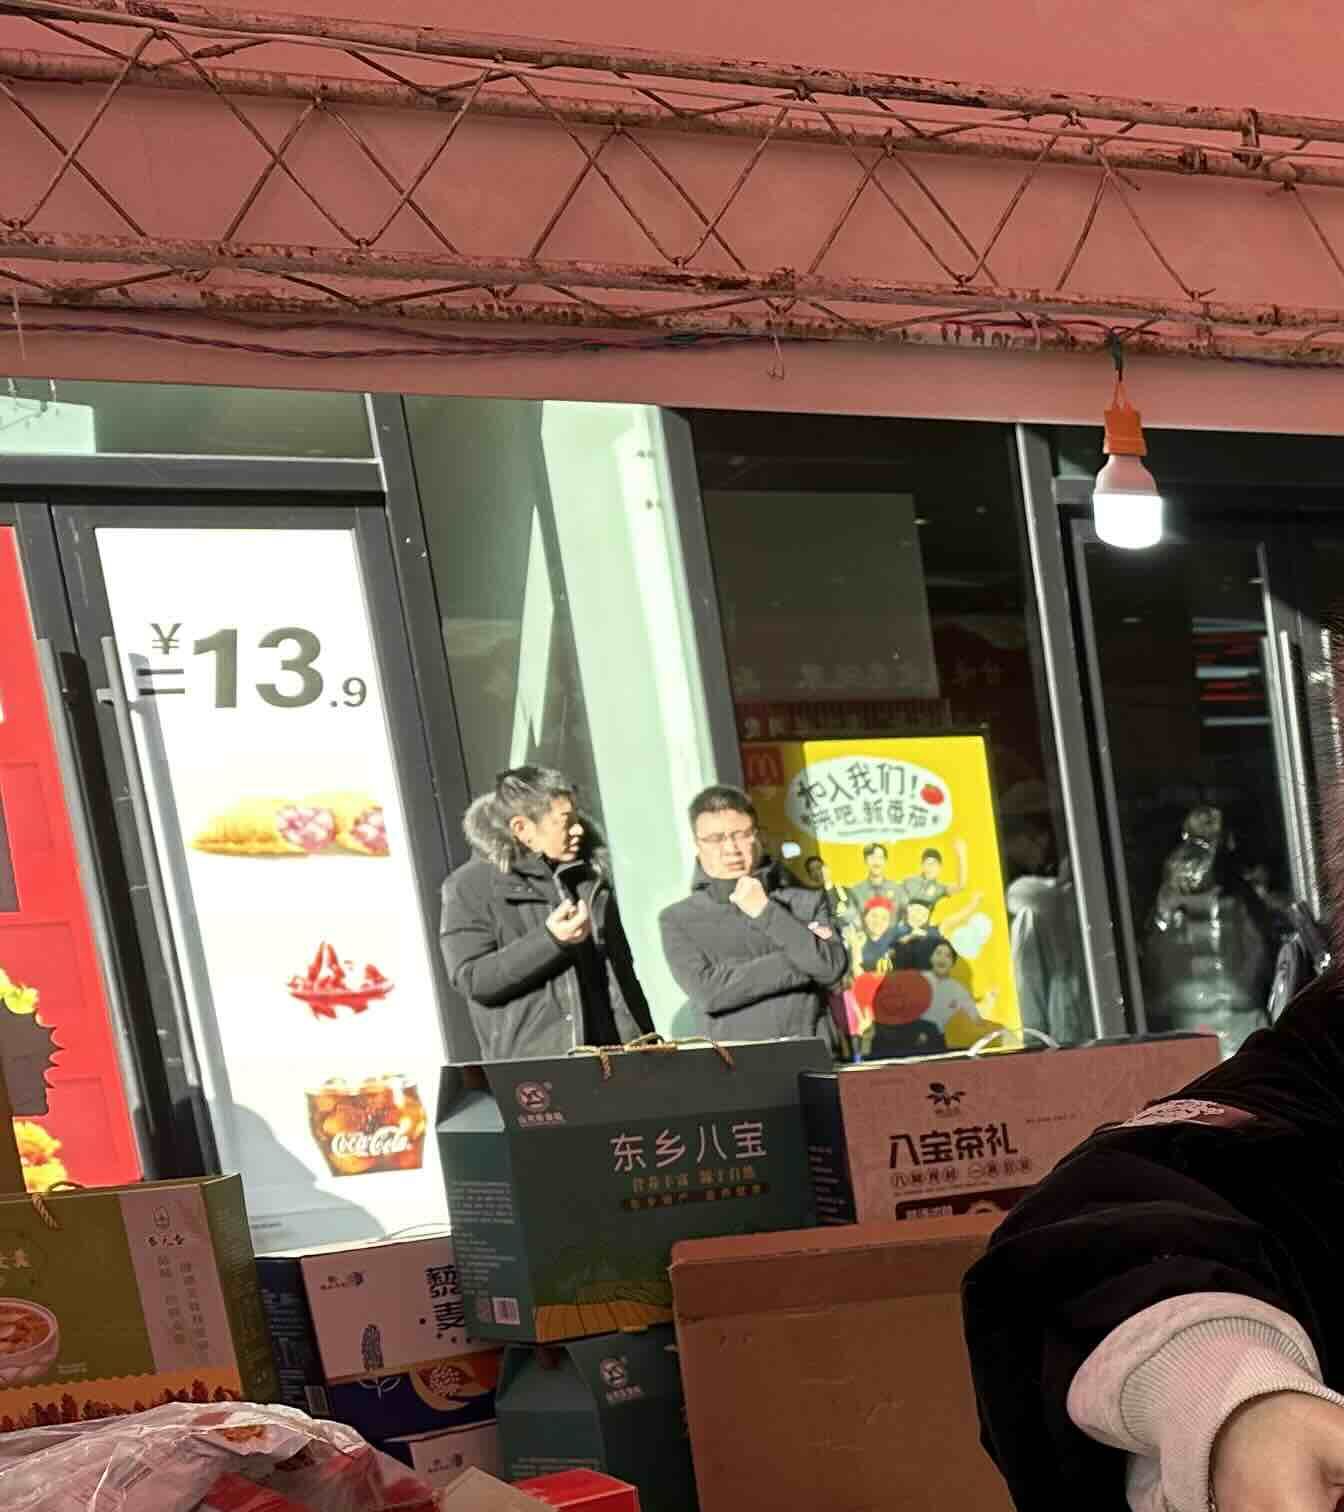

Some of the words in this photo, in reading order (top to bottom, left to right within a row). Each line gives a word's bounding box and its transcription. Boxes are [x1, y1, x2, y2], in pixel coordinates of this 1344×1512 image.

[609, 1121, 768, 1173] 东乡八宝
[889, 1122, 1019, 1169] 八宝茶礼
